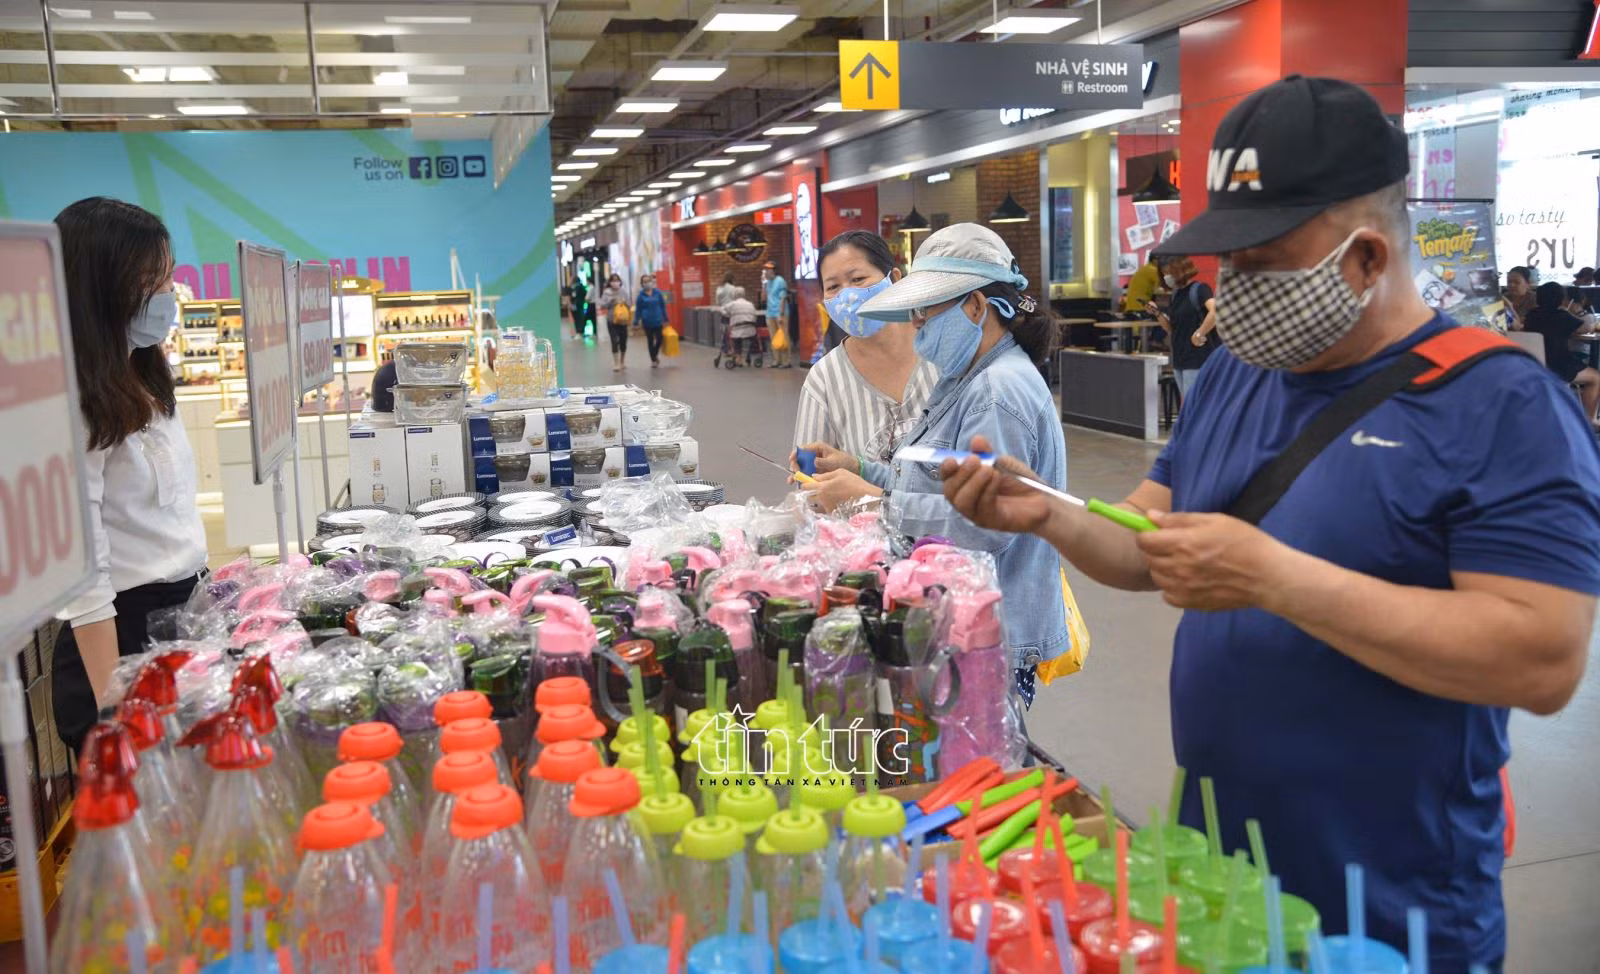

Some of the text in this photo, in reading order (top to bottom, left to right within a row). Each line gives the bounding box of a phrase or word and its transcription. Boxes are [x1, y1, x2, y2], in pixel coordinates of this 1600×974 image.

[1071, 58, 1091, 79] VỆ
[1092, 62, 1128, 76] SINH
[1077, 81, 1128, 93] Restroom
[353, 156, 403, 170] Follow
[364, 170, 404, 181] us on
